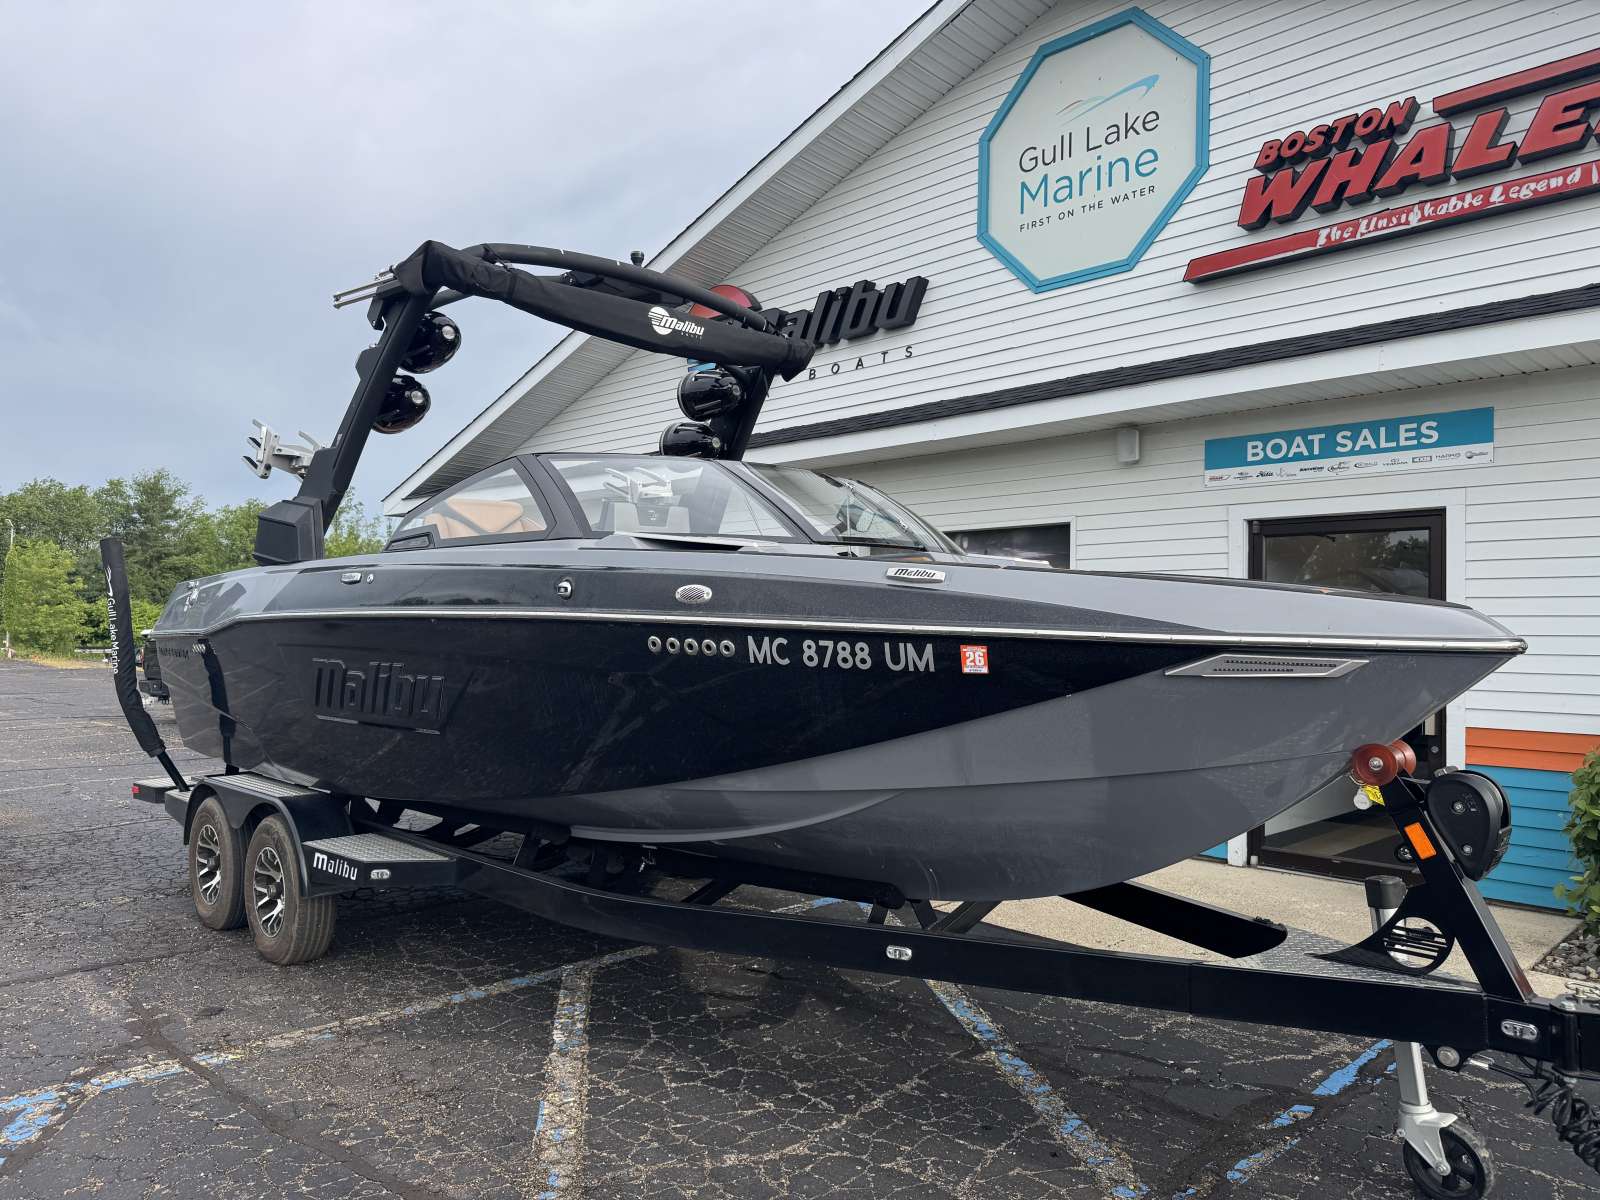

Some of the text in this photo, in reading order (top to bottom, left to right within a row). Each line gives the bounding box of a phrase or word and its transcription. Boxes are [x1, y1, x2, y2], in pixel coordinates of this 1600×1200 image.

[1019, 110, 1160, 173] Gull Lake
[1238, 79, 1600, 230] WHALE
[1254, 96, 1418, 171] BOSTON
[1020, 148, 1159, 214] Marine
[1019, 185, 1156, 233] FIRST ON THE WATER
[1317, 226, 1353, 249] The
[1489, 166, 1582, 202] Legend
[660, 315, 705, 336] Malibu
[808, 345, 914, 381] BOATS
[1247, 421, 1439, 462] BOAT SALES
[107, 597, 118, 617] Gull
[747, 635, 936, 673] MC 8788 UM
[965, 651, 985, 666] 26
[312, 657, 445, 721] Malibu
[312, 851, 358, 881] Malibu
